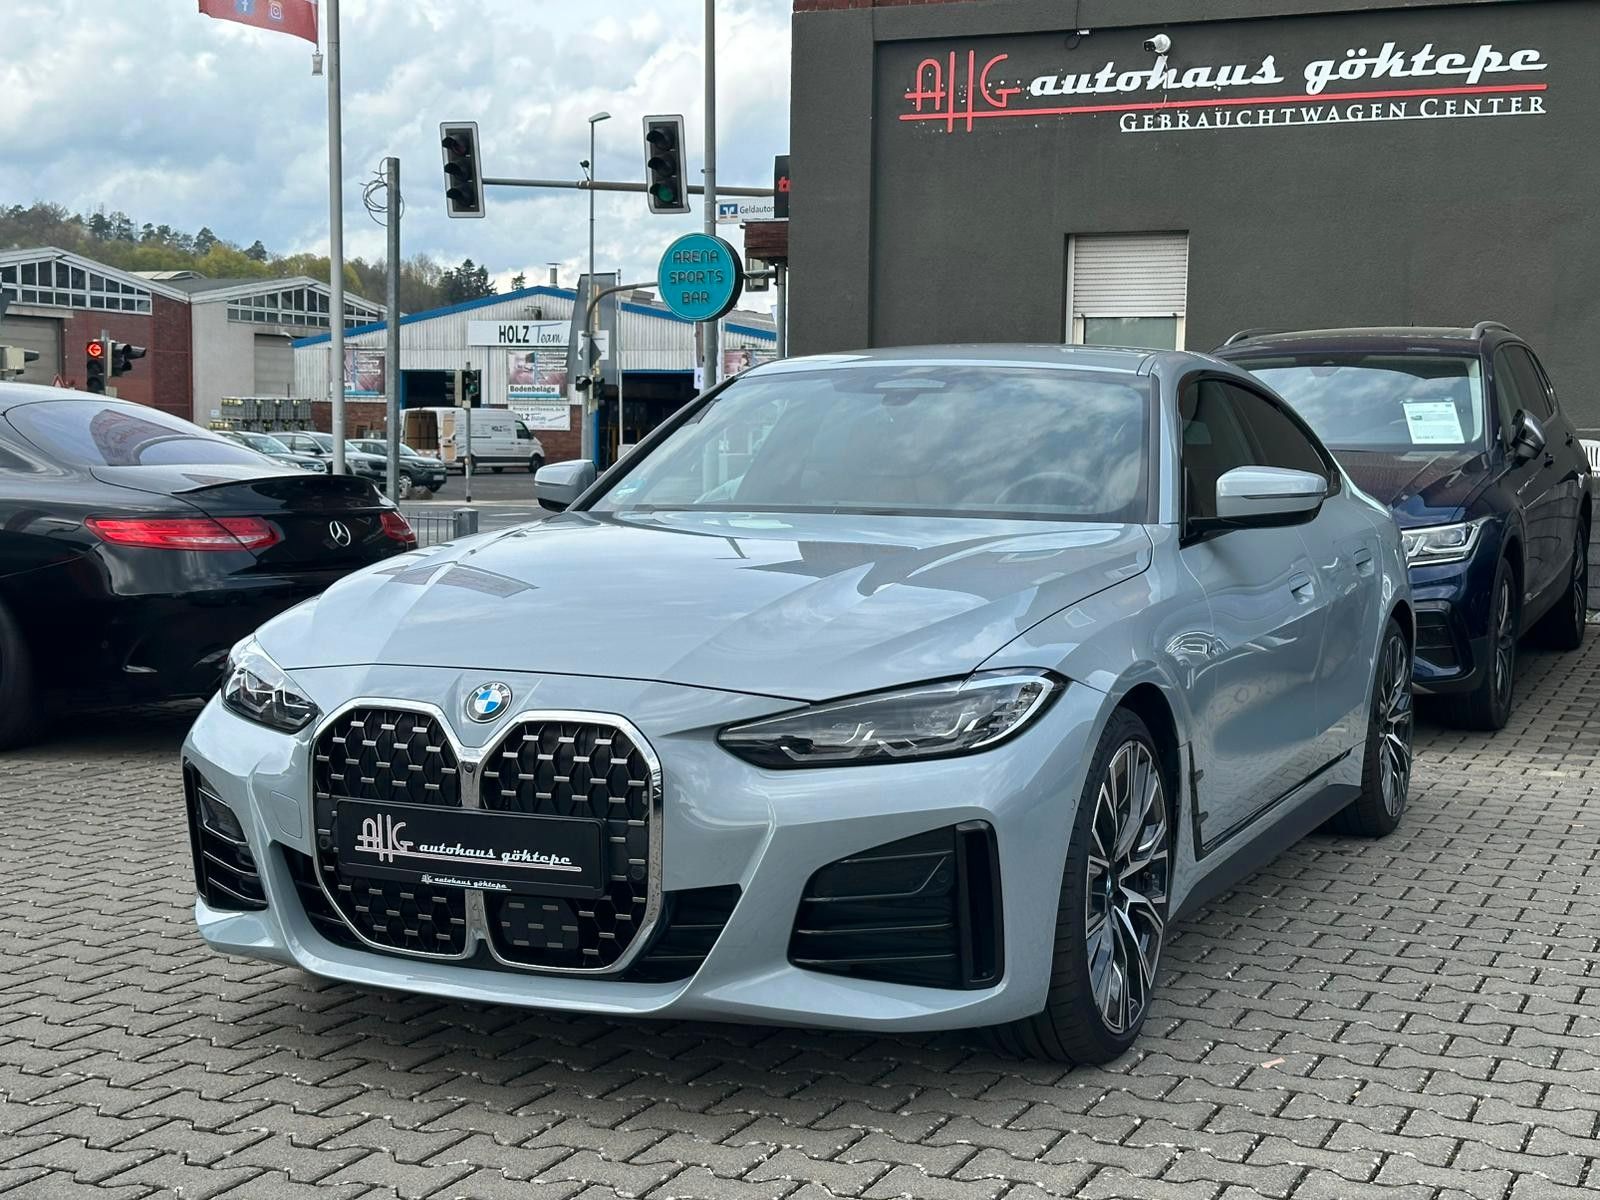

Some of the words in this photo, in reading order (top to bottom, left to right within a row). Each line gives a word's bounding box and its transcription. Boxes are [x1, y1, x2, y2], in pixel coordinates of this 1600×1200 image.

[1030, 55, 1284, 97] autohaus
[1304, 42, 1548, 95] göktepe
[672, 249, 719, 264] ARENA
[669, 270, 724, 285] SPORTS
[682, 291, 710, 305] BAR
[498, 325, 530, 344] HOLZ
[531, 322, 563, 344] Team
[419, 843, 496, 859] autohaus
[501, 849, 572, 866] göktepe
[434, 877, 471, 886] autohaus
[473, 879, 508, 889] göktepe
